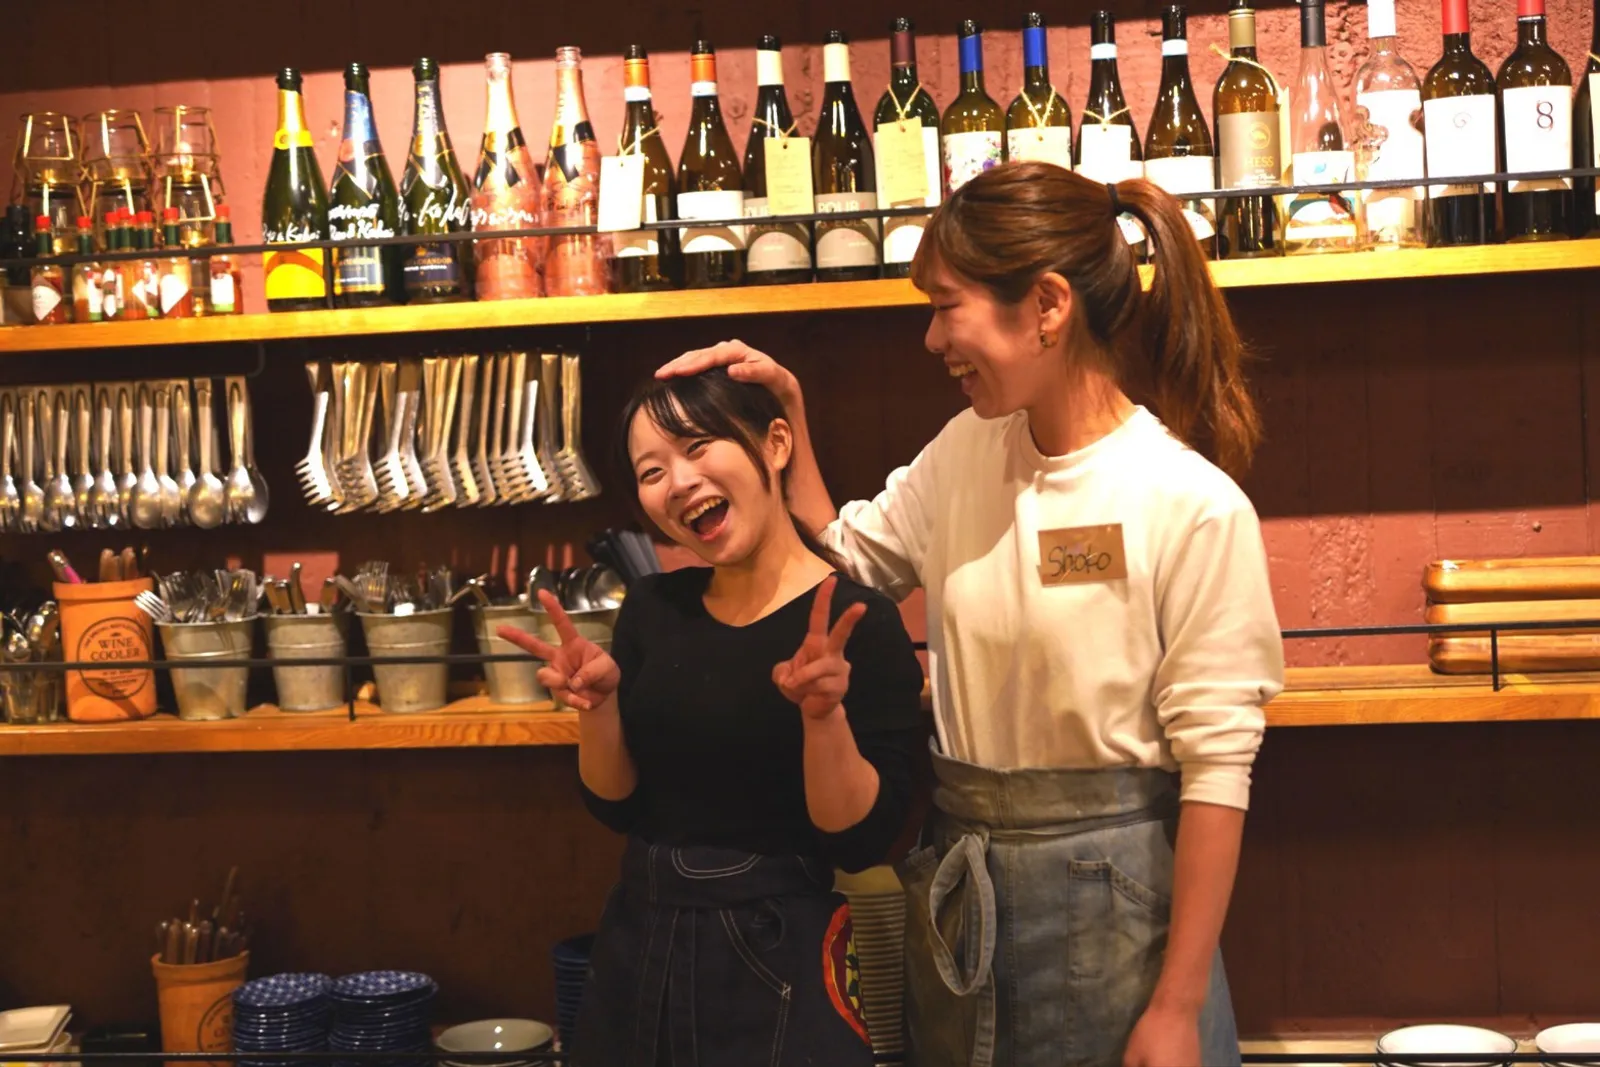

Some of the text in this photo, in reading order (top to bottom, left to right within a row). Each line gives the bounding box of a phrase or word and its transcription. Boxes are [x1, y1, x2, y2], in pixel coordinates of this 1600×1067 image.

[1536, 100, 1555, 131] 8
[1048, 544, 1112, 577] Shoko
[98, 637, 133, 649] WINE
[90, 648, 140, 661] COOLER
